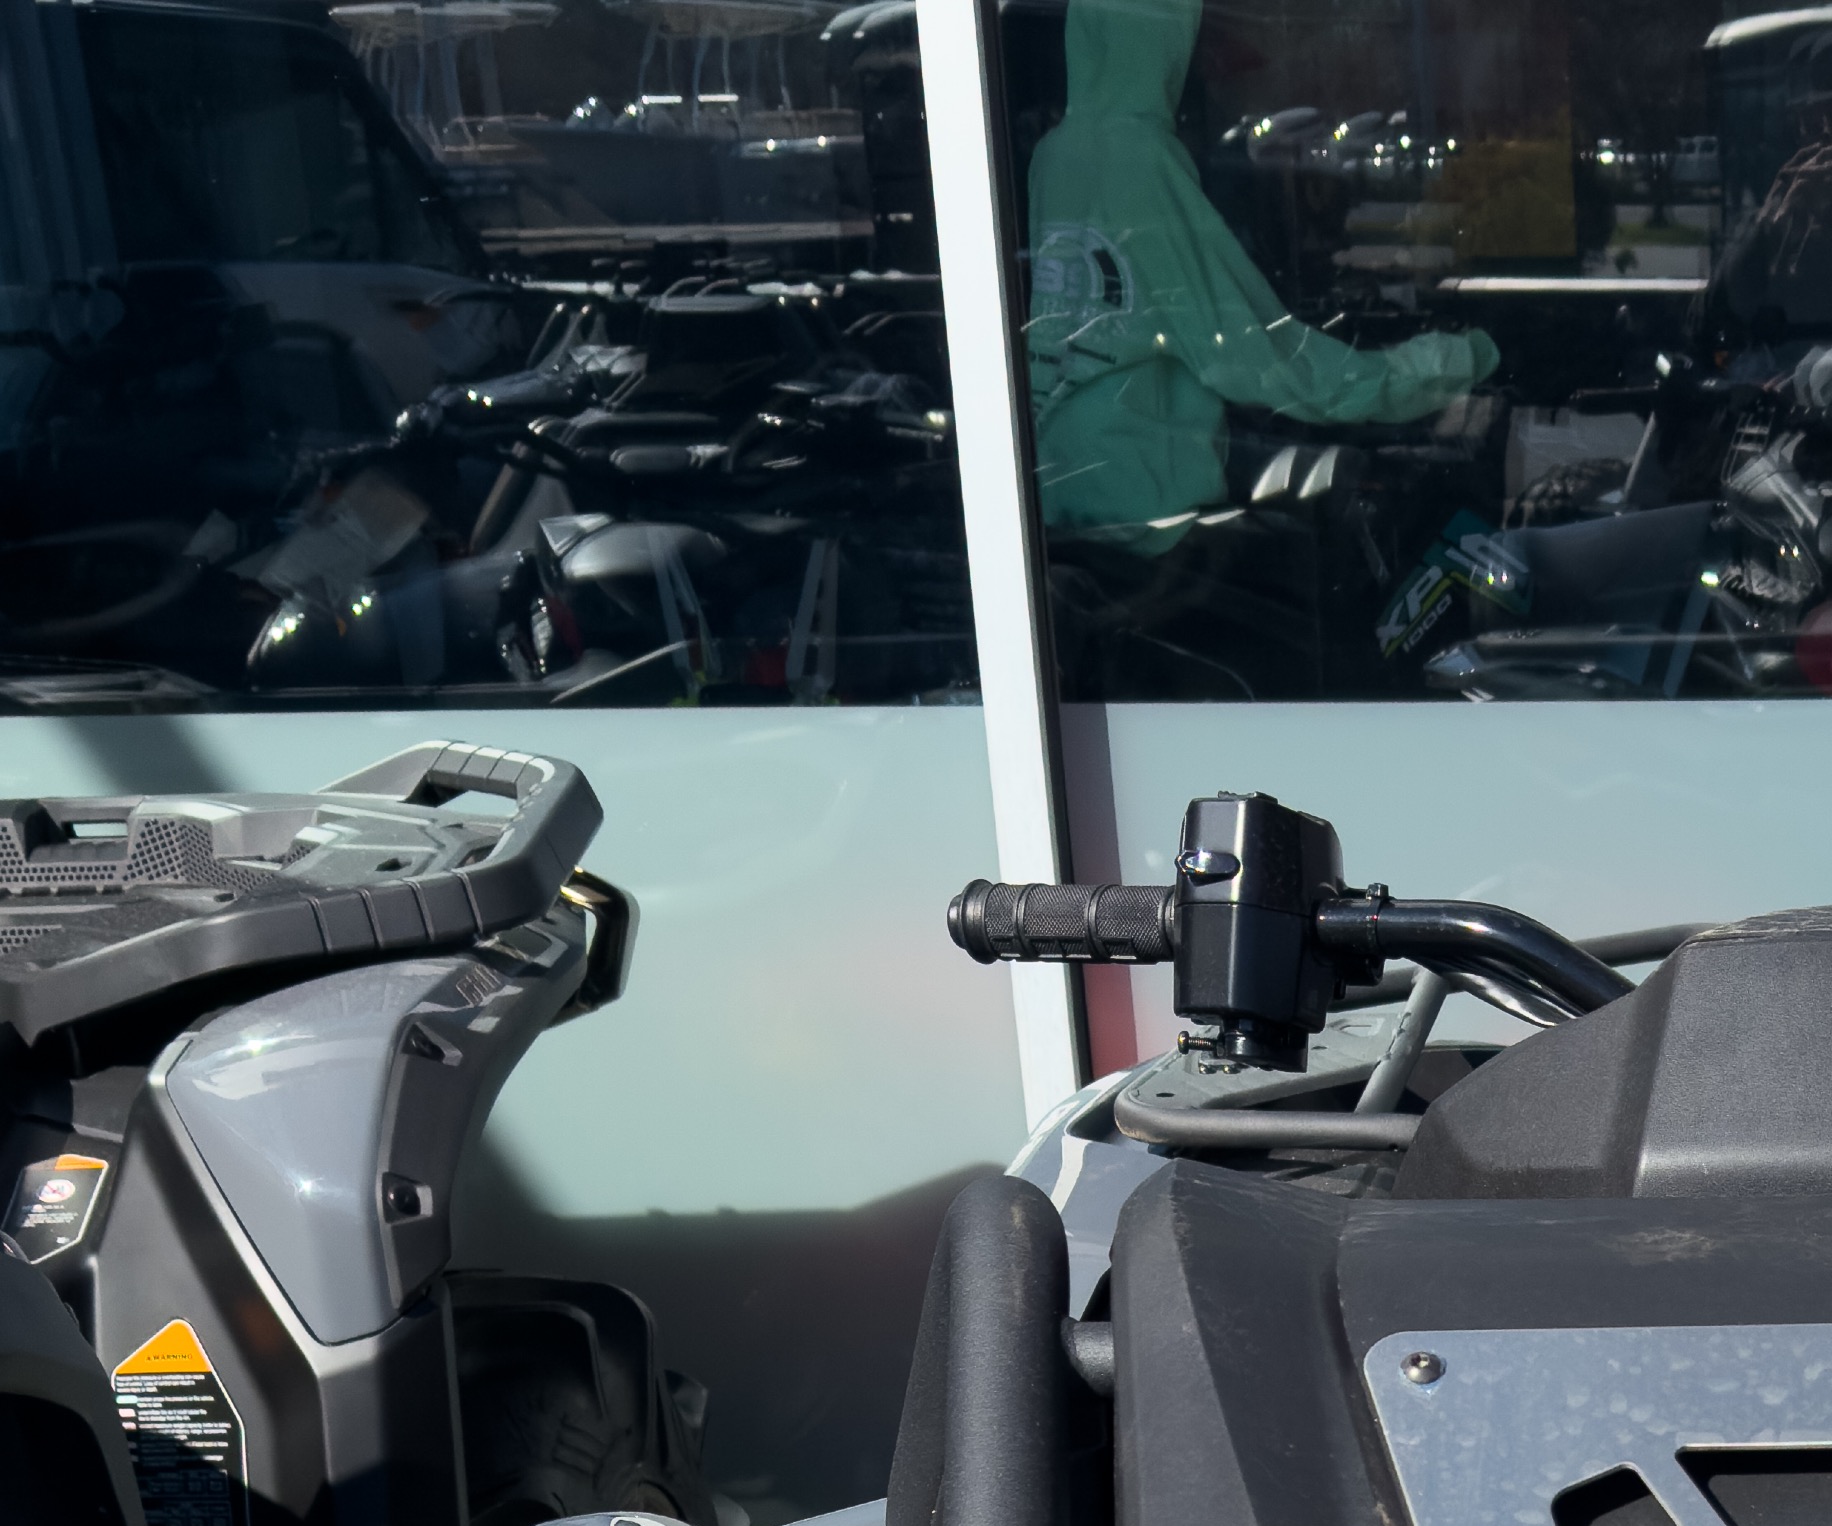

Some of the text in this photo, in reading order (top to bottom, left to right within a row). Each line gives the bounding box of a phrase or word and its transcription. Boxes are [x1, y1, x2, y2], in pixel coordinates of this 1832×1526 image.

[1376, 565, 1443, 652] XP
[1403, 594, 1452, 653] 1000
[153, 1353, 193, 1361] WARNING
